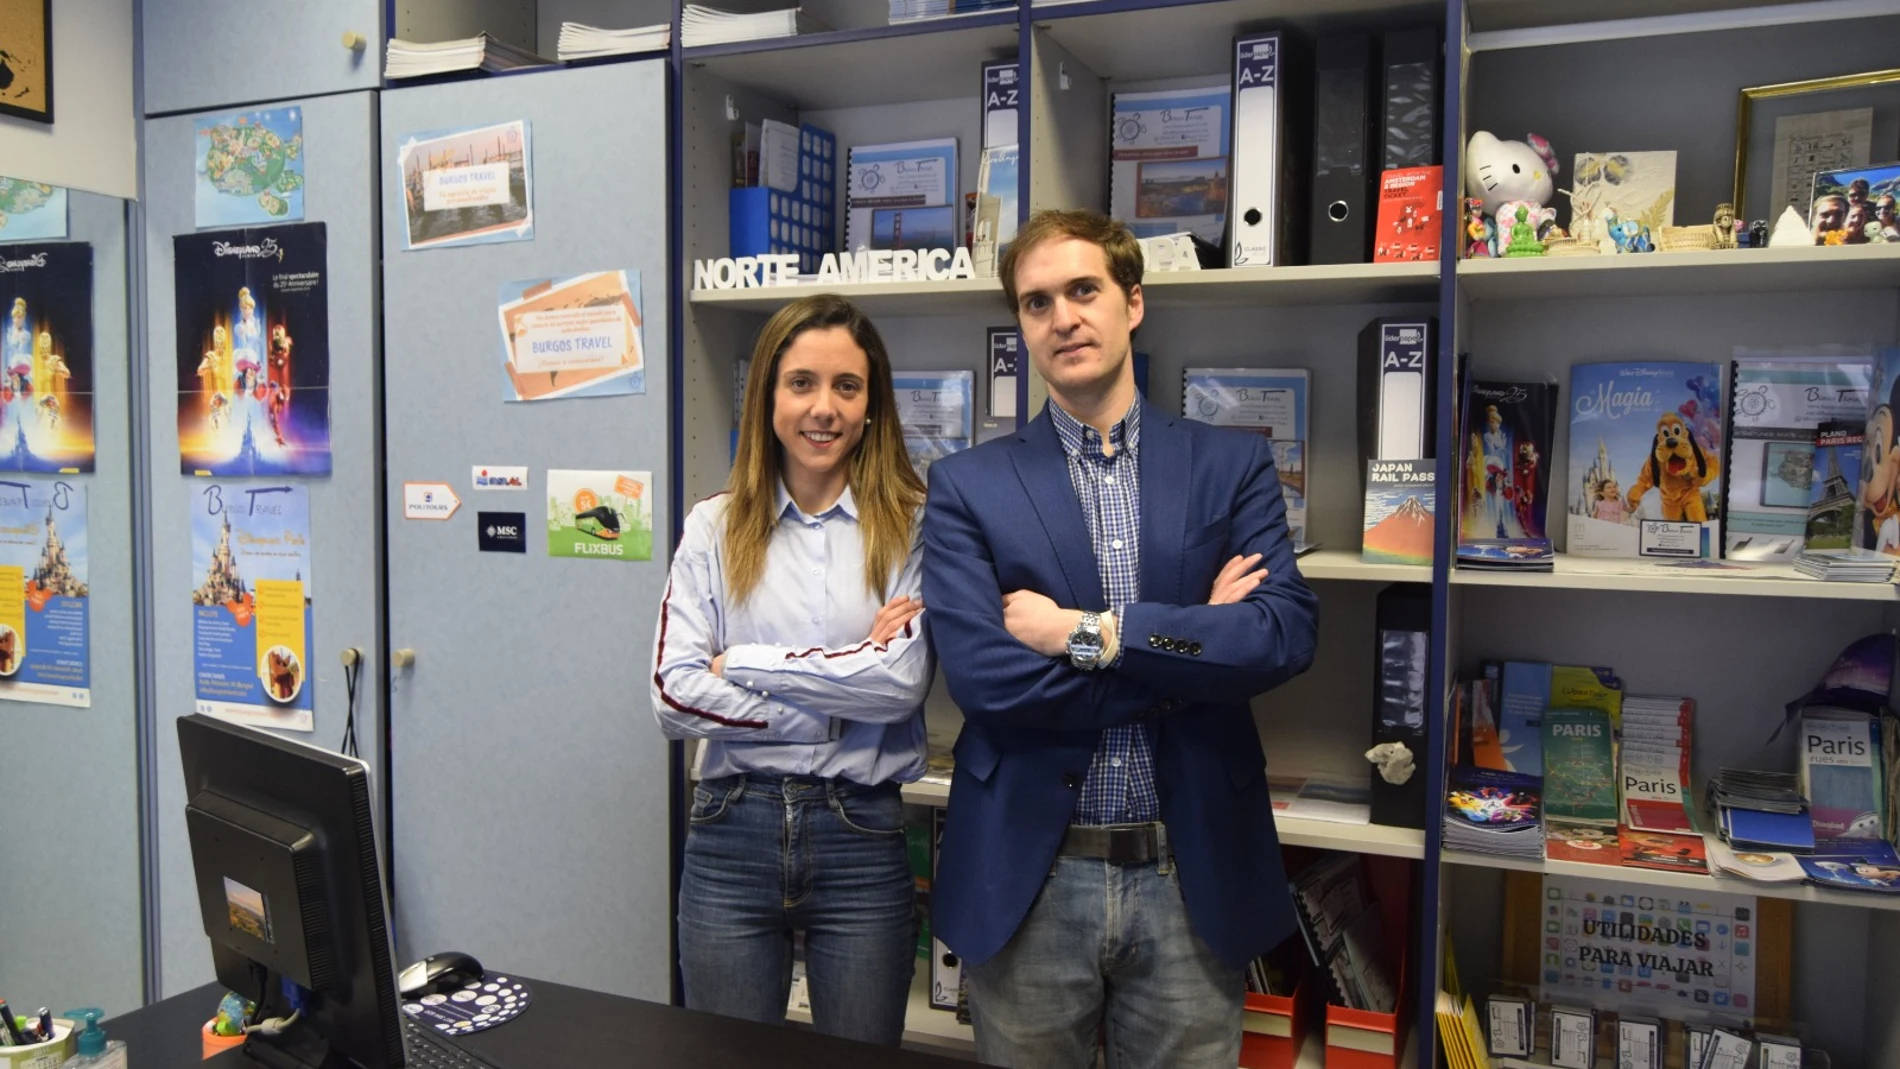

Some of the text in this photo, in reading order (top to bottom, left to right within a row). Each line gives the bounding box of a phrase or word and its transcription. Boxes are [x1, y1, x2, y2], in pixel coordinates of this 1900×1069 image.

[1240, 65, 1274, 84] A-Z
[988, 90, 1018, 107] A-Z
[470, 169, 495, 181] TRAVEL
[1384, 175, 1426, 183] AMSTERDAM
[695, 247, 976, 289] NORTE AMERICA
[532, 336, 612, 353] BURGOS TRAVEL
[1384, 351, 1422, 368] A-Z
[1575, 380, 1654, 419] Magia
[1372, 463, 1412, 472] JAPAN
[1372, 472, 1435, 482] RAIL PASS
[409, 503, 448, 511] POLITOURS
[497, 525, 518, 535] MSC
[1552, 724, 1602, 737] PARIS
[1808, 735, 1866, 756] Paris
[1625, 776, 1677, 795] Paris
[1583, 919, 1706, 948] UTILIDADES
[1579, 946, 1714, 977] PARA VIAJAR
